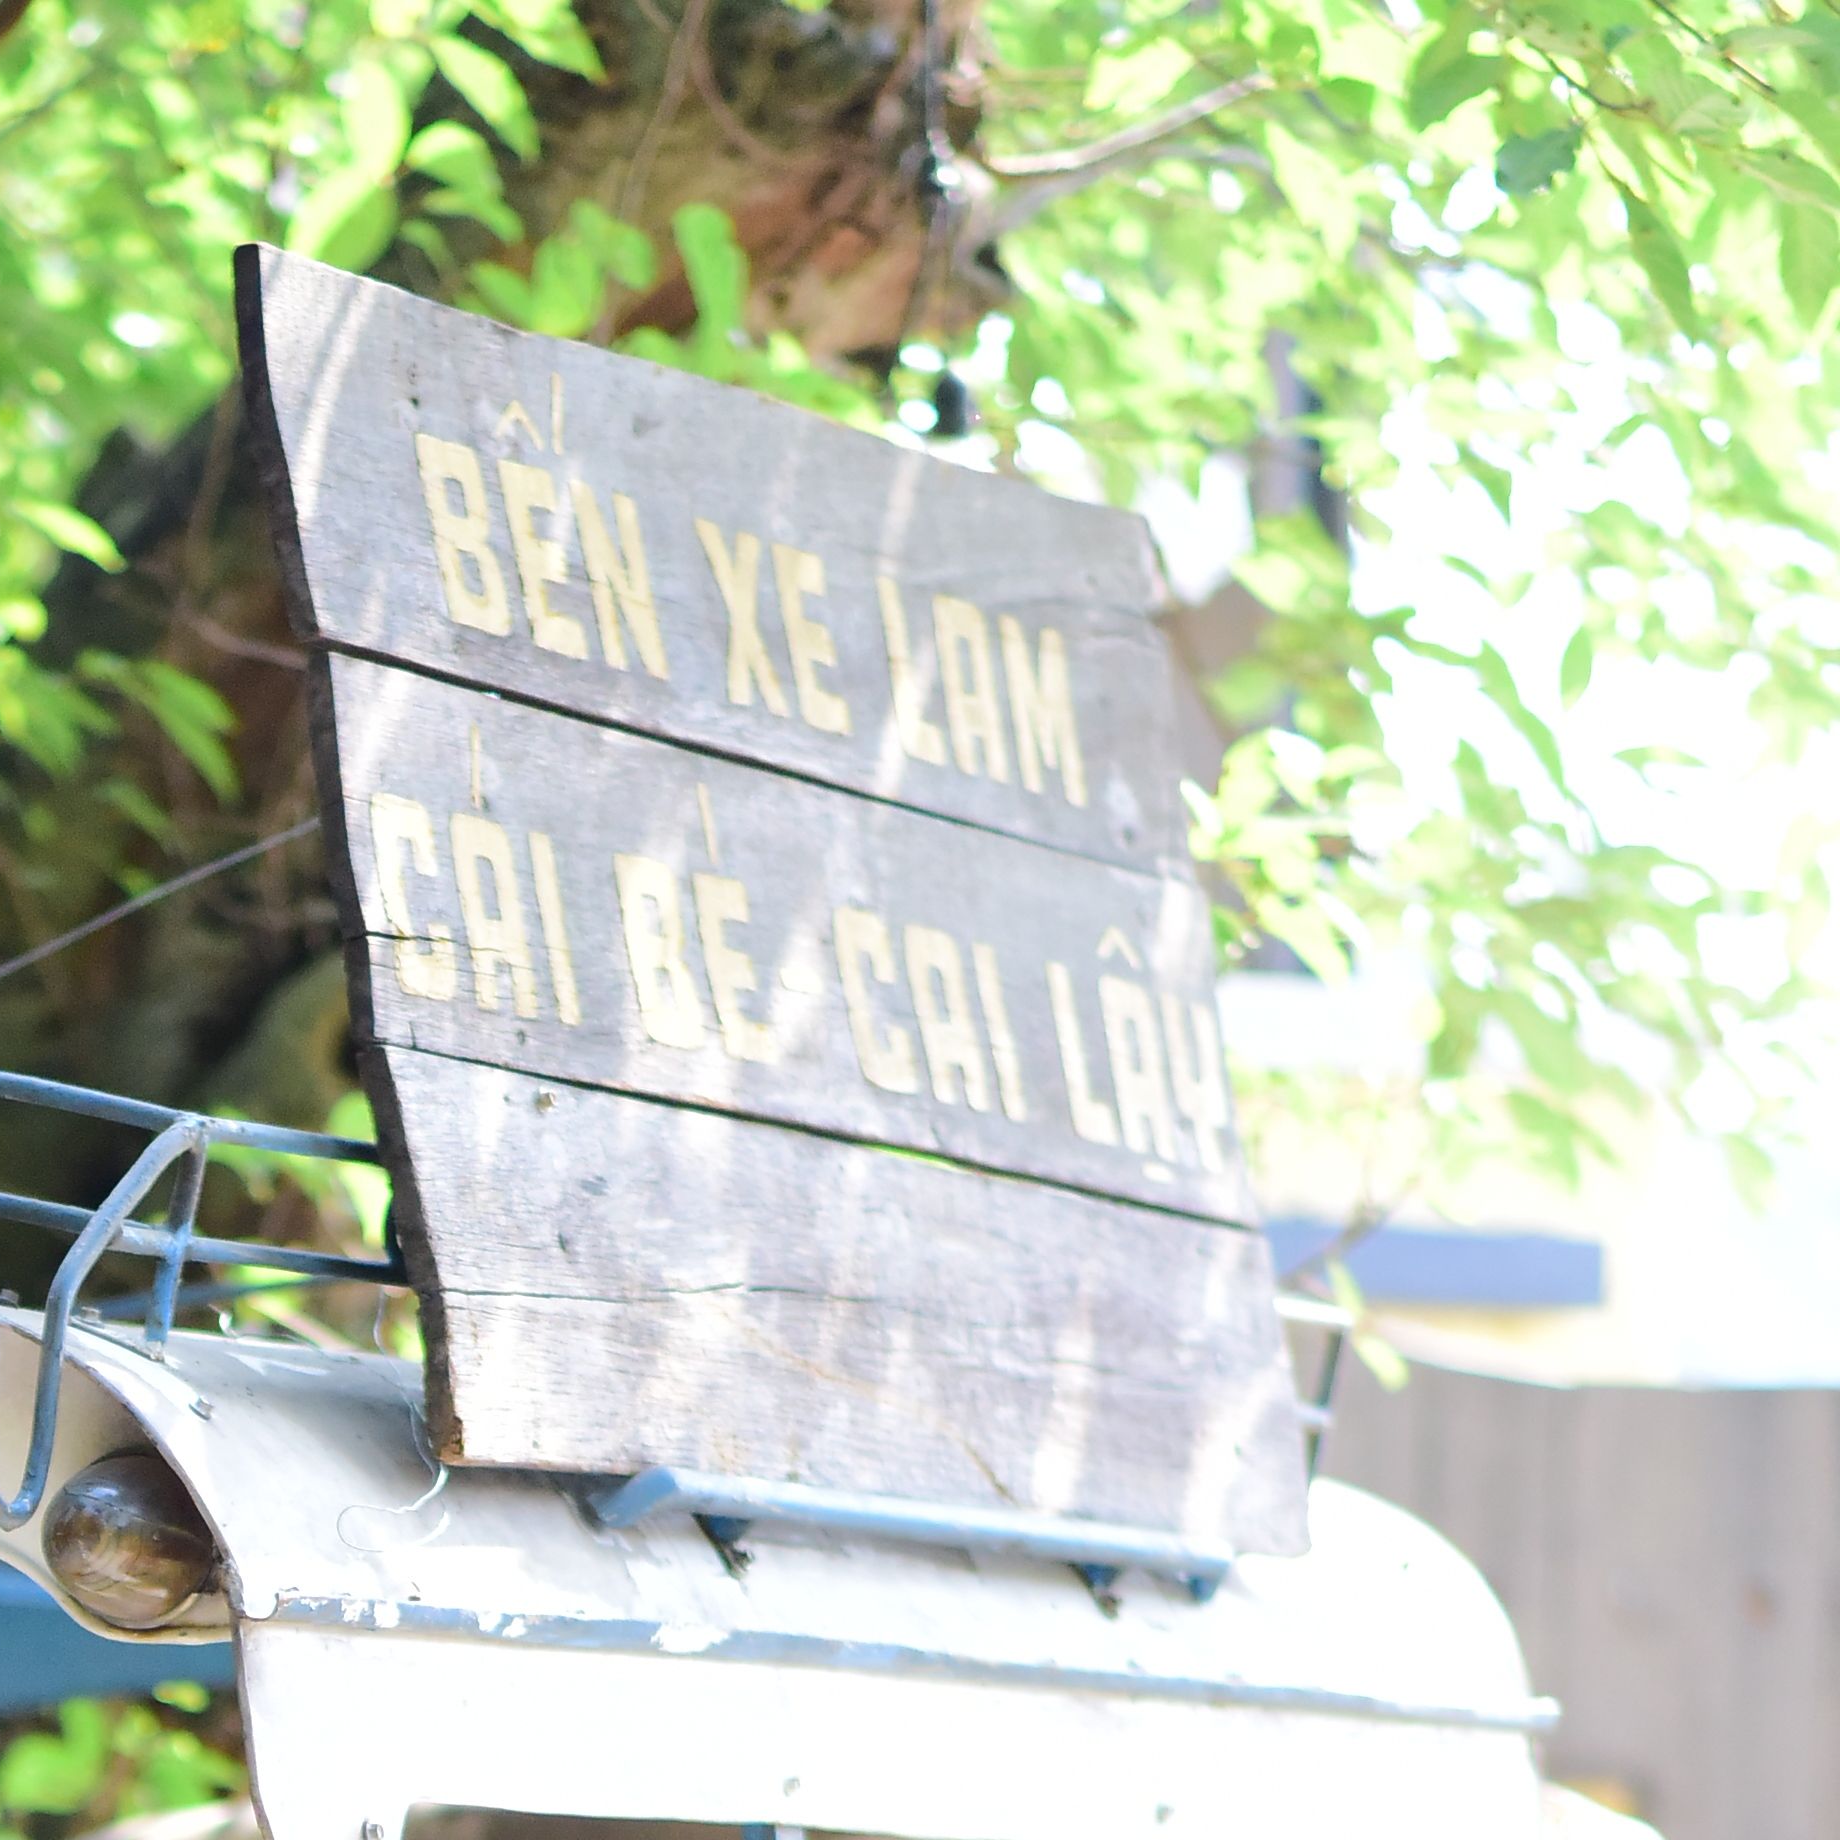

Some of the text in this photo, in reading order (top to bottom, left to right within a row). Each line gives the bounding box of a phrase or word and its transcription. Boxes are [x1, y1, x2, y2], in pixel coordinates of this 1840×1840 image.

[414, 371, 1088, 808] BẾN XE LAM
[833, 905, 1027, 1123] CAI
